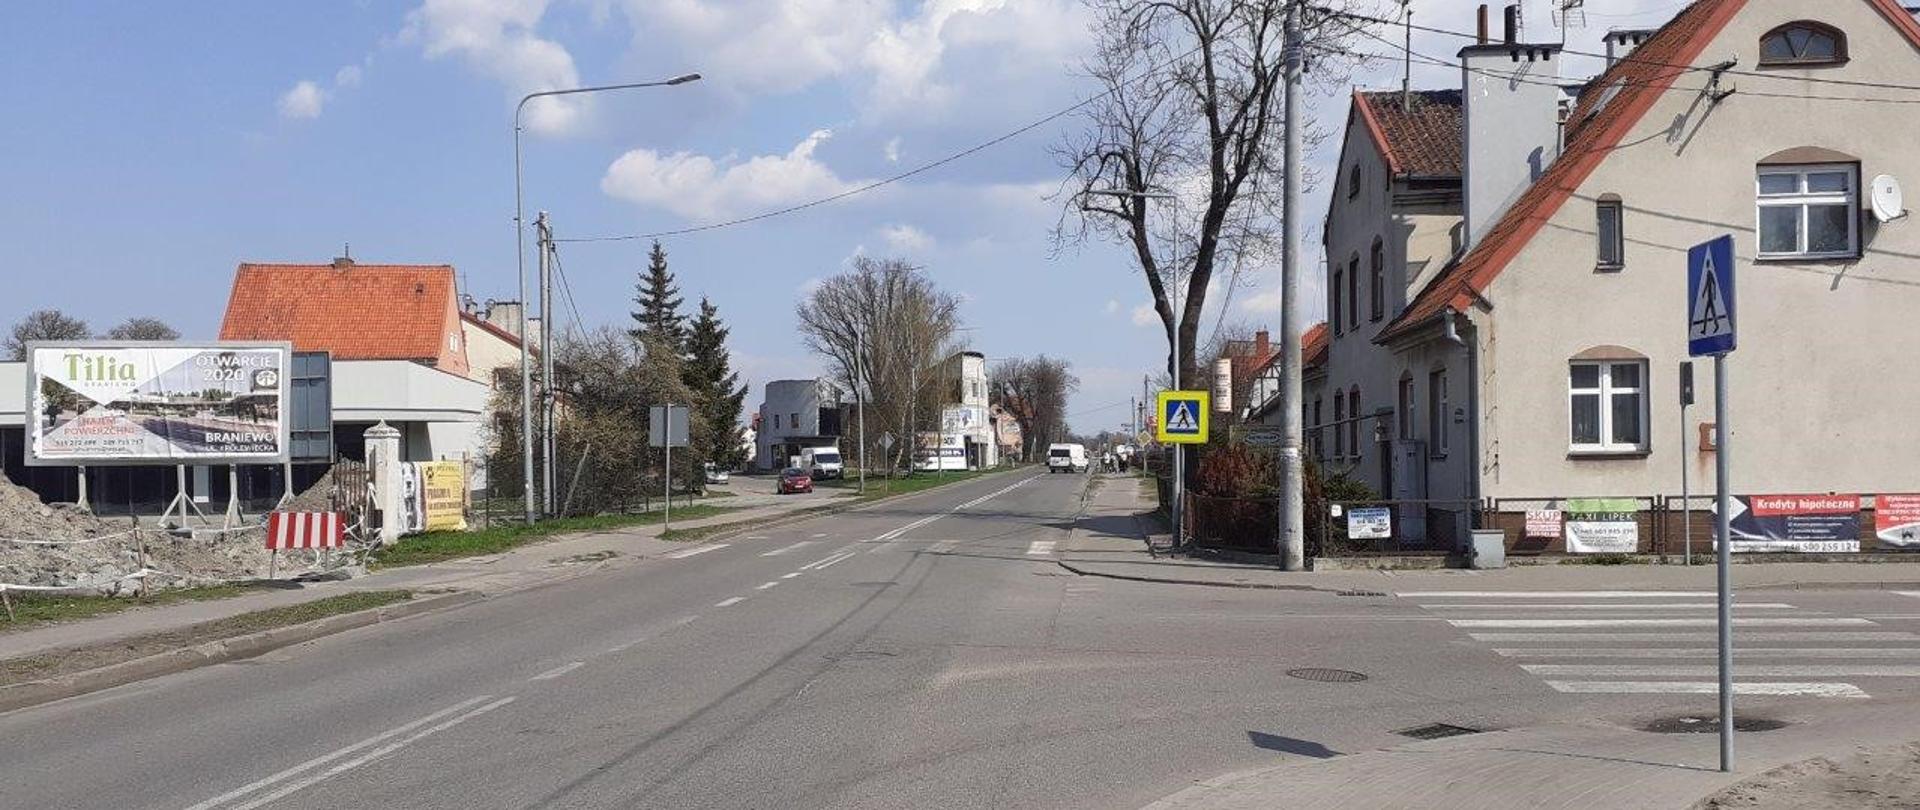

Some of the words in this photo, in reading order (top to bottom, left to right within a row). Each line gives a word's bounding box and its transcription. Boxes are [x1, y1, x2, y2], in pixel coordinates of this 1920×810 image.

[196, 354, 273, 367] OTWARCIE
[63, 353, 136, 381] Tilia
[203, 368, 245, 382] 2020
[205, 432, 274, 443] BRANIEWO
[1757, 499, 1797, 510] Kredyty
[1799, 497, 1855, 510] hipoteczne
[1527, 510, 1561, 521] SKUP
[1571, 513, 1597, 521] TAXI
[1602, 513, 1634, 521] LIPEK
[1804, 542, 1820, 551] 500
[1821, 542, 1838, 551] 255
